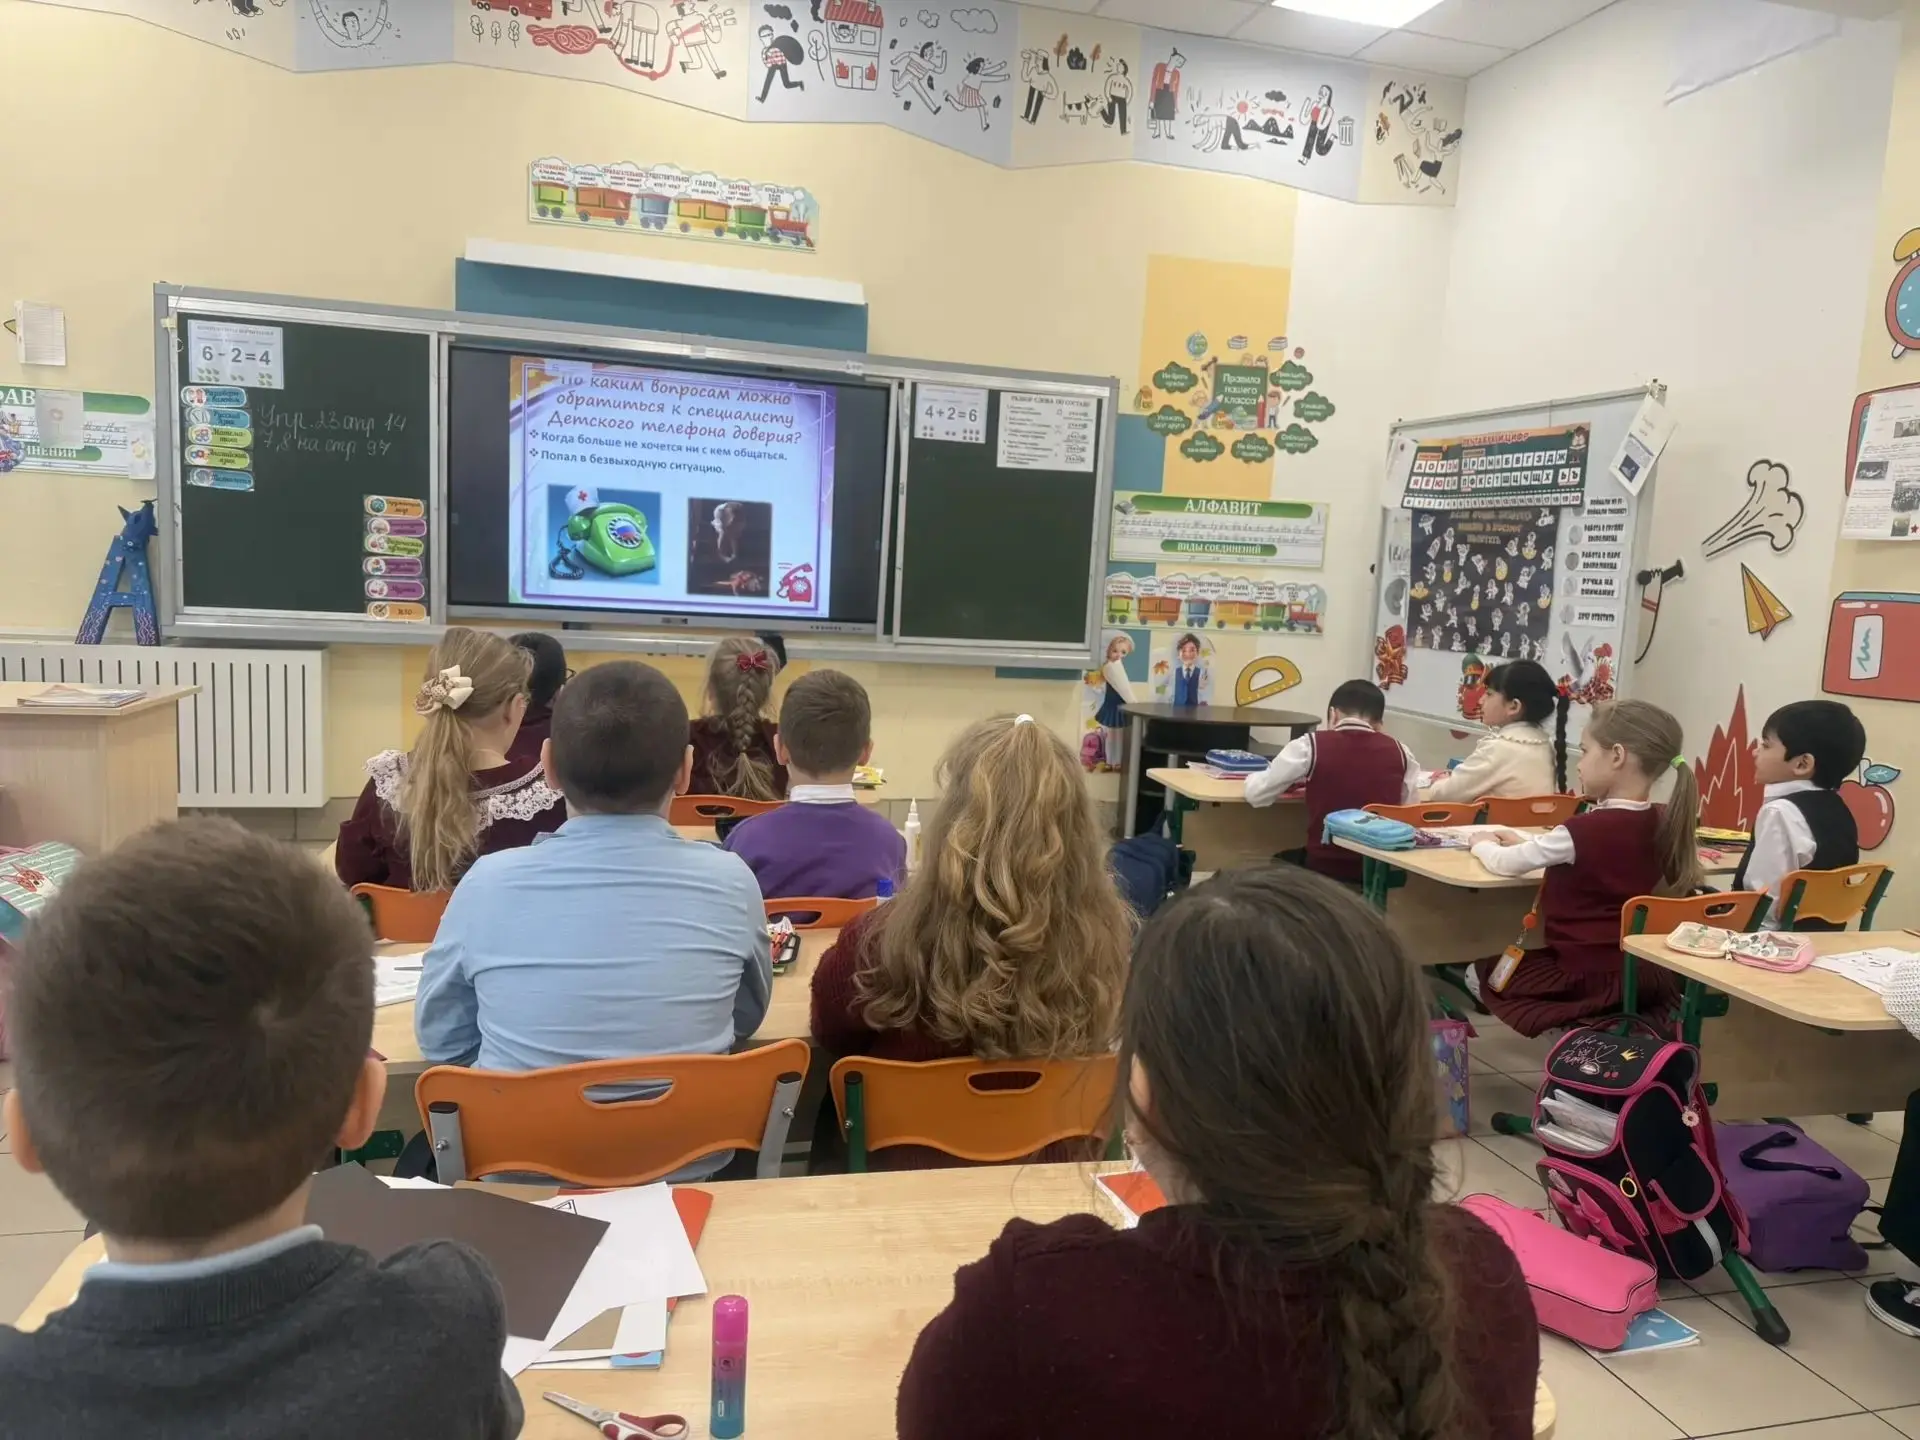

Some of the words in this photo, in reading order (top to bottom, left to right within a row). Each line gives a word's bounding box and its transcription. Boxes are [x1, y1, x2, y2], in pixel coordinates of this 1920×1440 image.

[202, 346, 213, 361] 6
[231, 347, 242, 363] 2
[245, 352, 256, 360] =
[259, 350, 271, 366] 4
[1223, 373, 1261, 385] Правила
[590, 376, 644, 393] каким
[651, 379, 730, 401] вопросам
[736, 390, 792, 405] можно
[1225, 386, 1258, 395] нашего
[556, 389, 665, 413] обратиться
[671, 404, 682, 415] к
[687, 406, 794, 428] специалисту
[925, 405, 934, 419] 4
[936, 408, 944, 417] +
[947, 406, 956, 420] 2
[969, 408, 978, 422] 6
[384, 413, 407, 432] 14
[547, 410, 634, 430] Детского
[641, 420, 726, 440] телефона
[733, 425, 802, 447] доверия?
[297, 437, 321, 452] на
[325, 439, 356, 461] стр
[541, 431, 575, 444] Когда
[577, 434, 622, 447] больше
[624, 440, 638, 448] не
[641, 441, 682, 452] хочется
[702, 446, 708, 454] с
[710, 448, 731, 456] кем
[734, 448, 788, 461] общаться.
[541, 450, 577, 463] Попал
[580, 454, 587, 462] в
[590, 454, 667, 470] безвыходную
[669, 462, 725, 474] ситуацию.
[1184, 499, 1262, 515] АЛФАВИТ
[1177, 542, 1203, 552] ВИДЫ
[1204, 543, 1262, 554] СОЕДИНЕНИЙ
